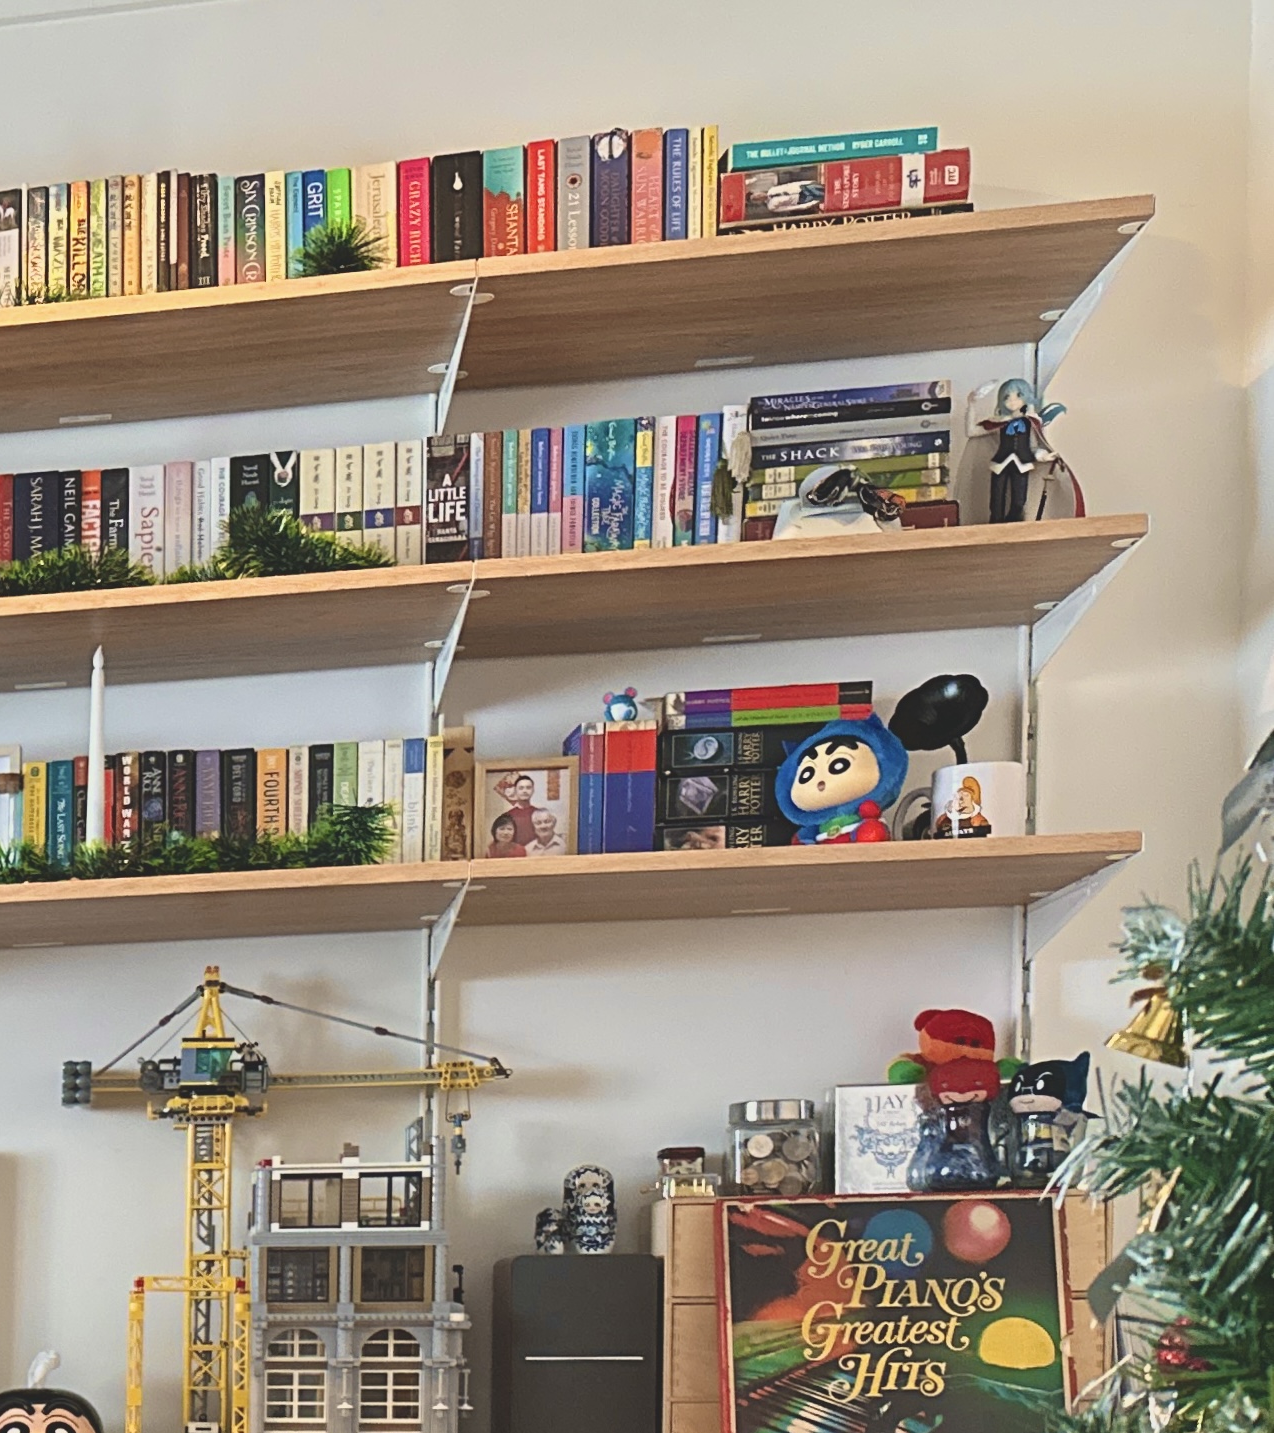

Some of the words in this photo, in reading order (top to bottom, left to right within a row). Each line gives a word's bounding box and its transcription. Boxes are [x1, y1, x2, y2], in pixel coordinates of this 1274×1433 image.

[537, 149, 545, 172] LAST
[672, 138, 682, 158] THE
[537, 173, 545, 196] TANG
[672, 161, 682, 193] RULES
[307, 182, 323, 218] GRIT
[409, 181, 421, 226] CRAZY
[610, 172, 619, 232] DAUGHTER
[671, 195, 682, 208] OF
[537, 197, 545, 241] STANDING
[671, 212, 681, 232] LIFE
[72, 237, 85, 271] KILL
[409, 230, 421, 264] RICH
[764, 394, 811, 406] MIRACLES
[679, 431, 687, 476] DEPARTMENT
[779, 447, 840, 462] SHACK
[442, 473, 452, 487] A
[660, 473, 667, 481] TO
[678, 478, 686, 501] STORE
[64, 477, 76, 509] NEIL
[109, 499, 120, 517] The
[428, 486, 467, 501] LITTLE
[428, 501, 467, 523] LIFE
[591, 497, 600, 535] COLLECTION
[109, 518, 124, 549] Farm
[743, 732, 753, 765] HARRY
[753, 732, 763, 763] POTTER
[121, 756, 132, 805] WORLD
[142, 772, 153, 793] RICE
[152, 767, 162, 795] ANNE
[172, 769, 187, 802] ANNE
[232, 764, 241, 779] DEL
[232, 782, 241, 802] TORO
[263, 772, 280, 823] FOURTH
[738, 775, 750, 815] HARRY
[751, 774, 764, 816] POTTER
[57, 813, 66, 833] LAST
[121, 808, 133, 838] WAR
[172, 803, 188, 831] RICE
[407, 802, 419, 834] blink
[56, 834, 66, 859] SONG
[874, 1094, 908, 1114] JAY
[804, 1218, 925, 1280] Great
[836, 1263, 1006, 1315] PIANO'S
[800, 1301, 972, 1361] Greatest
[829, 1346, 948, 1405] HITS
